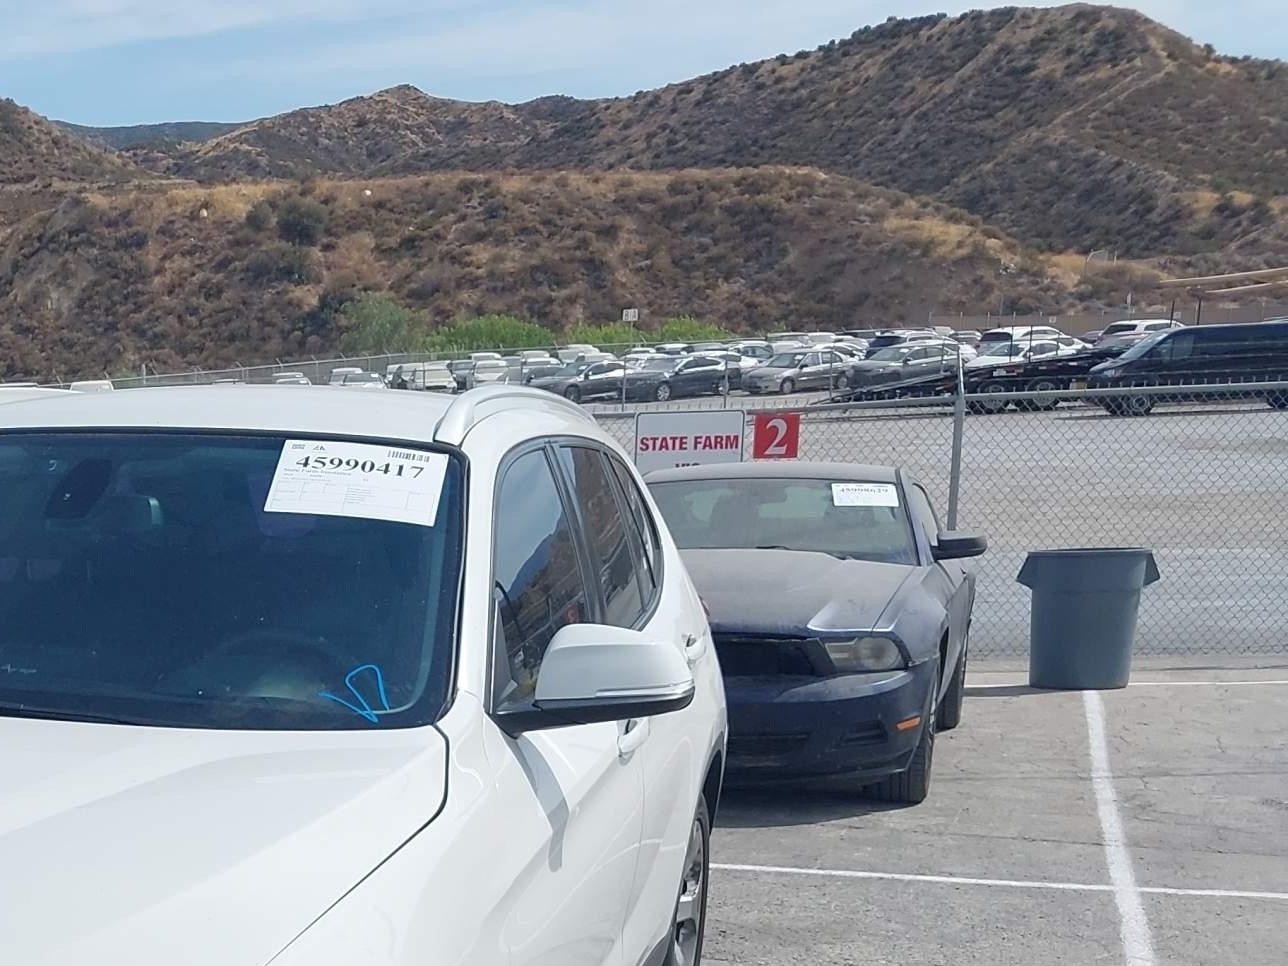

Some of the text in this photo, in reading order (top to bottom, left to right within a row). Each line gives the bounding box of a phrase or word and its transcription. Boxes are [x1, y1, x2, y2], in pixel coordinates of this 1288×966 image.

[639, 434, 739, 452] STATE FARM
[763, 418, 788, 455] 2
[296, 455, 425, 480] 45990417
